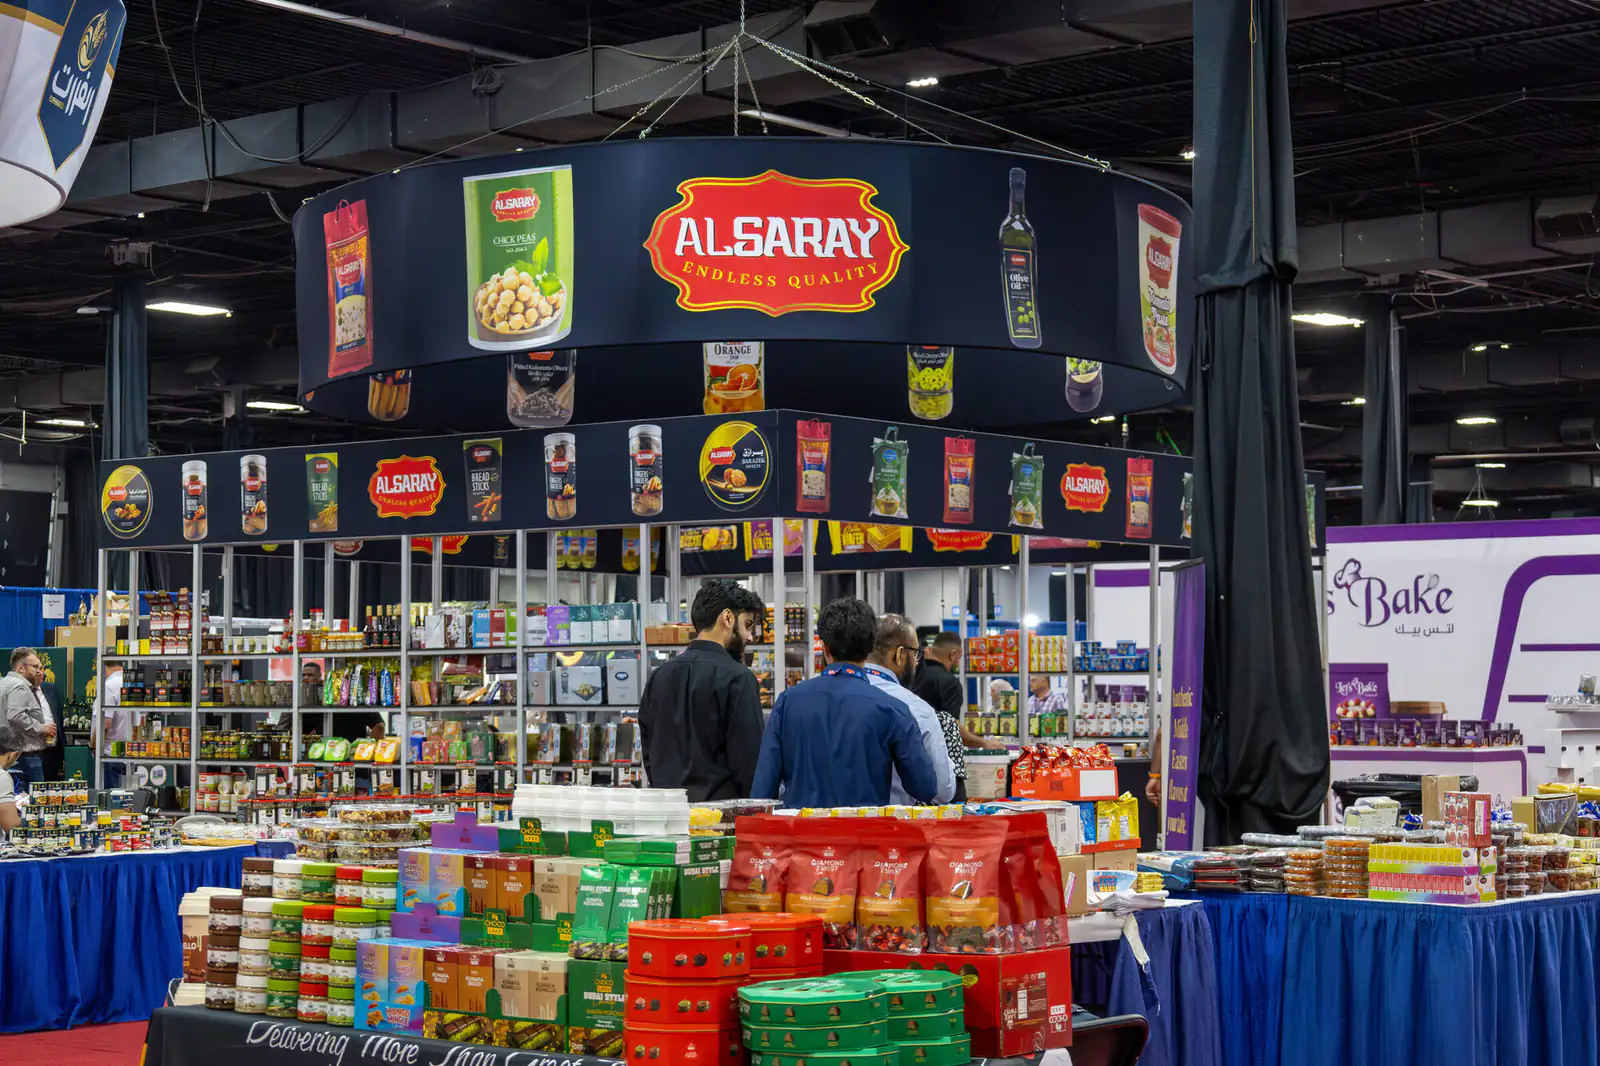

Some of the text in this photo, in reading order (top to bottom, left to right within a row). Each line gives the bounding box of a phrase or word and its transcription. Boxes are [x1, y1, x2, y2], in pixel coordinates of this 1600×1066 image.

[495, 196, 536, 210] ALSARAY
[493, 233, 536, 244] CHICK PEAS
[675, 216, 880, 258] ALSARAY
[682, 260, 878, 289] ENDLESS QUALITY
[1010, 273, 1029, 282] Olive
[1010, 282, 1021, 290] Oil
[714, 343, 751, 355] ORANGE
[471, 471, 490, 482] BREAD
[312, 482, 328, 492] BREAD
[376, 472, 437, 494] ALSARAY
[472, 481, 490, 492] STICKS
[1065, 476, 1106, 495] ALSARAY
[313, 491, 328, 501] STICKS
[1349, 574, 1454, 627] Bake
[1395, 623, 1454, 637] لتس بيك
[1354, 681, 1377, 695] Bake
[874, 861, 908, 869] DIAMOND
[484, 919, 506, 929] CHOCO
[557, 927, 573, 935] CHOC
[386, 1007, 411, 1018] MANGO
[387, 1013, 410, 1026] MINGLE
[1049, 1013, 1068, 1024] CHOCO
[246, 1020, 350, 1066] Delivering
[360, 1033, 419, 1064] More
